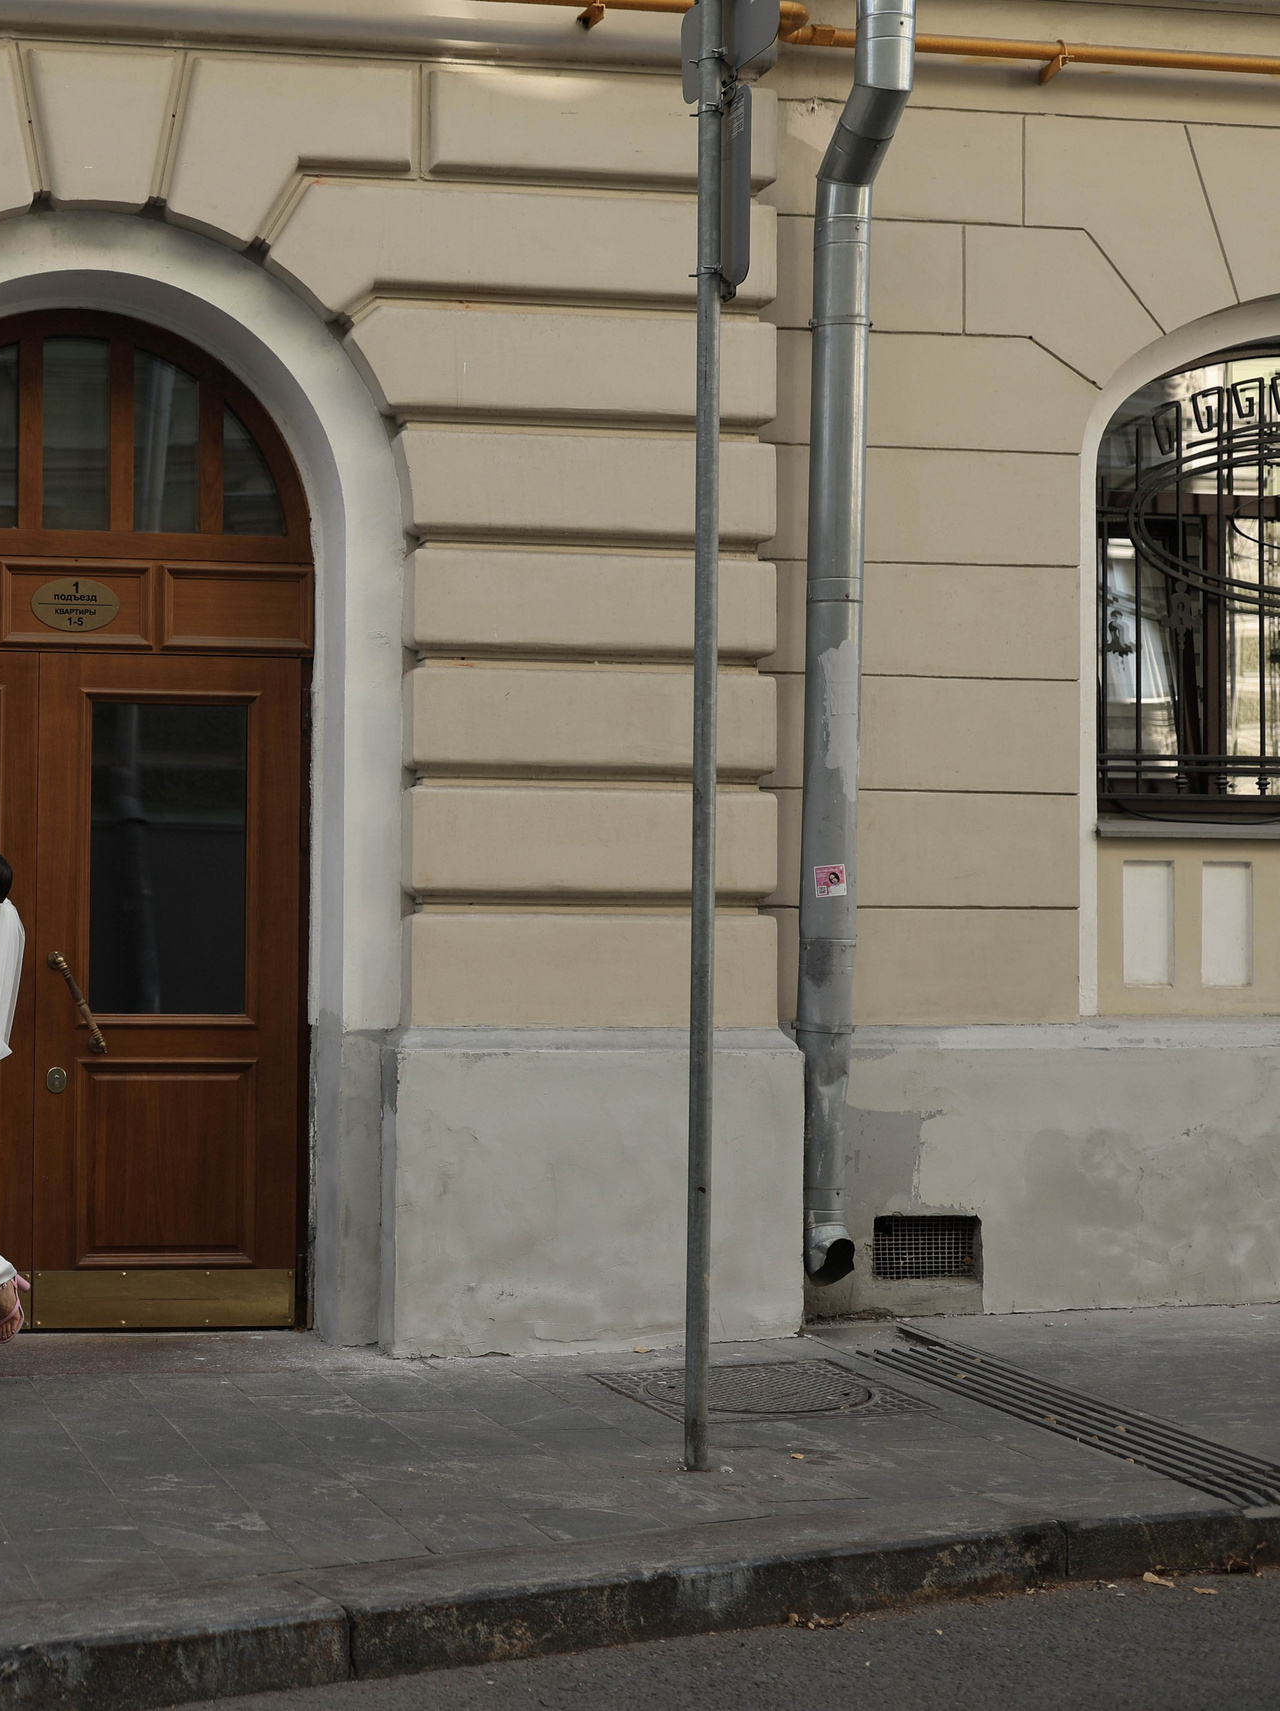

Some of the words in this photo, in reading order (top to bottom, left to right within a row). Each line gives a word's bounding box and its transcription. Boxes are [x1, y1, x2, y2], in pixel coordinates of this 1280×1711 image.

[72, 581, 79, 594] 1
[54, 593, 97, 602] подъезд
[54, 608, 97, 616] КВАРТИРЫ
[67, 616, 84, 626] 1-5
